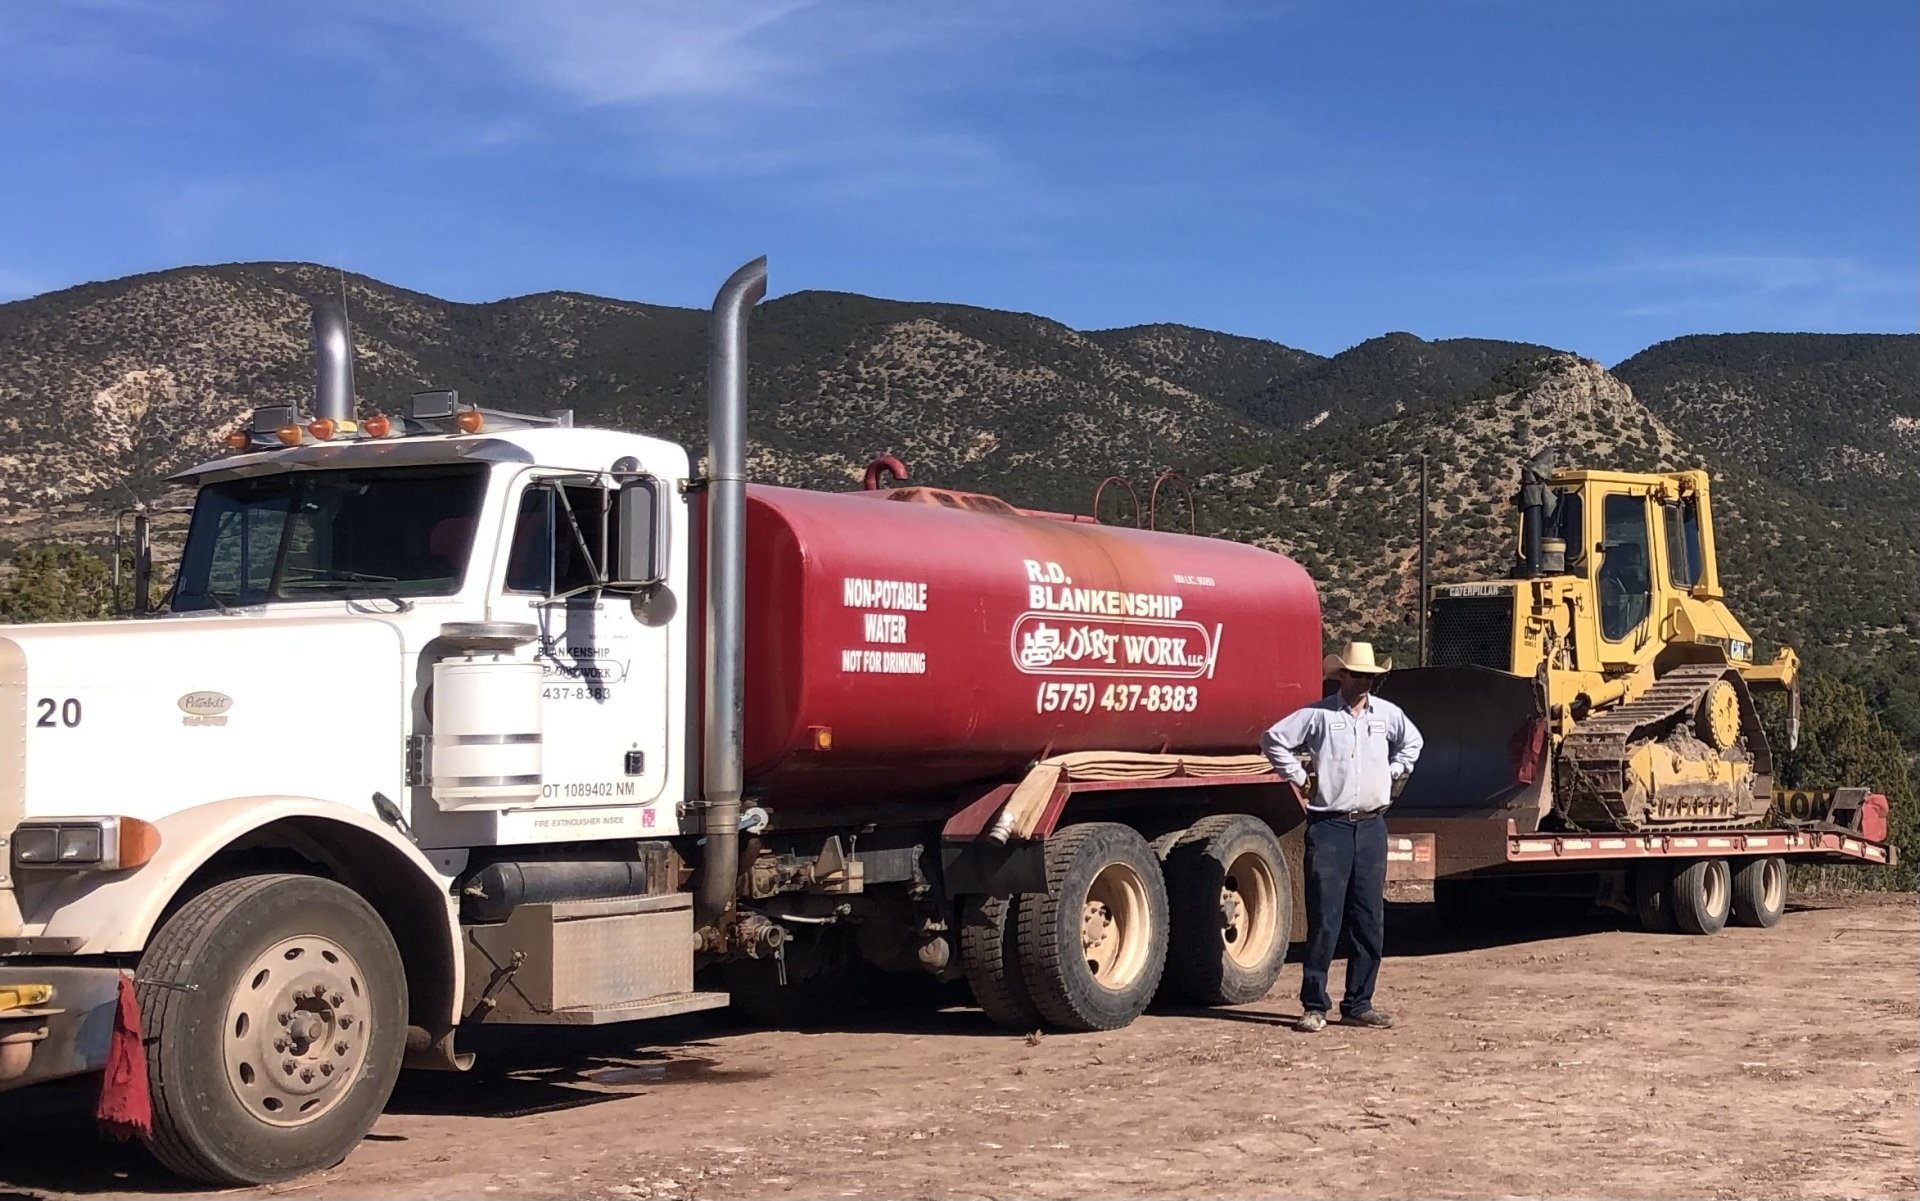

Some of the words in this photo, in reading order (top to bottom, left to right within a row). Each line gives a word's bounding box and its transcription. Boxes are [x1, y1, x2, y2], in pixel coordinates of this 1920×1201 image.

[1023, 559, 1072, 585] R.D.
[843, 577, 928, 611] NON-POTABLE
[1028, 585, 1183, 619] BLANKENSHIP
[1449, 585, 1499, 597] CATERPILLAR
[864, 613, 907, 644] WATER
[538, 646, 610, 658] BLANKENSHIP
[1064, 625, 1120, 664] DIRT
[1123, 635, 1188, 666] WORK
[1187, 654, 1205, 667] LLC
[841, 650, 863, 673] NOT
[862, 650, 882, 673] FOR
[882, 651, 926, 674] DRINKING
[542, 687, 611, 700] 437-8383
[1036, 681, 1096, 715] (575)
[1100, 683, 1199, 713] 437-8383
[36, 697, 82, 729] 20
[542, 784, 560, 798] OT
[564, 782, 613, 797] 1089402
[616, 781, 635, 796] NM
[534, 820, 549, 828] FIRE
[552, 817, 601, 827] EXTINGUISHER
[603, 816, 624, 825] INSIDE
